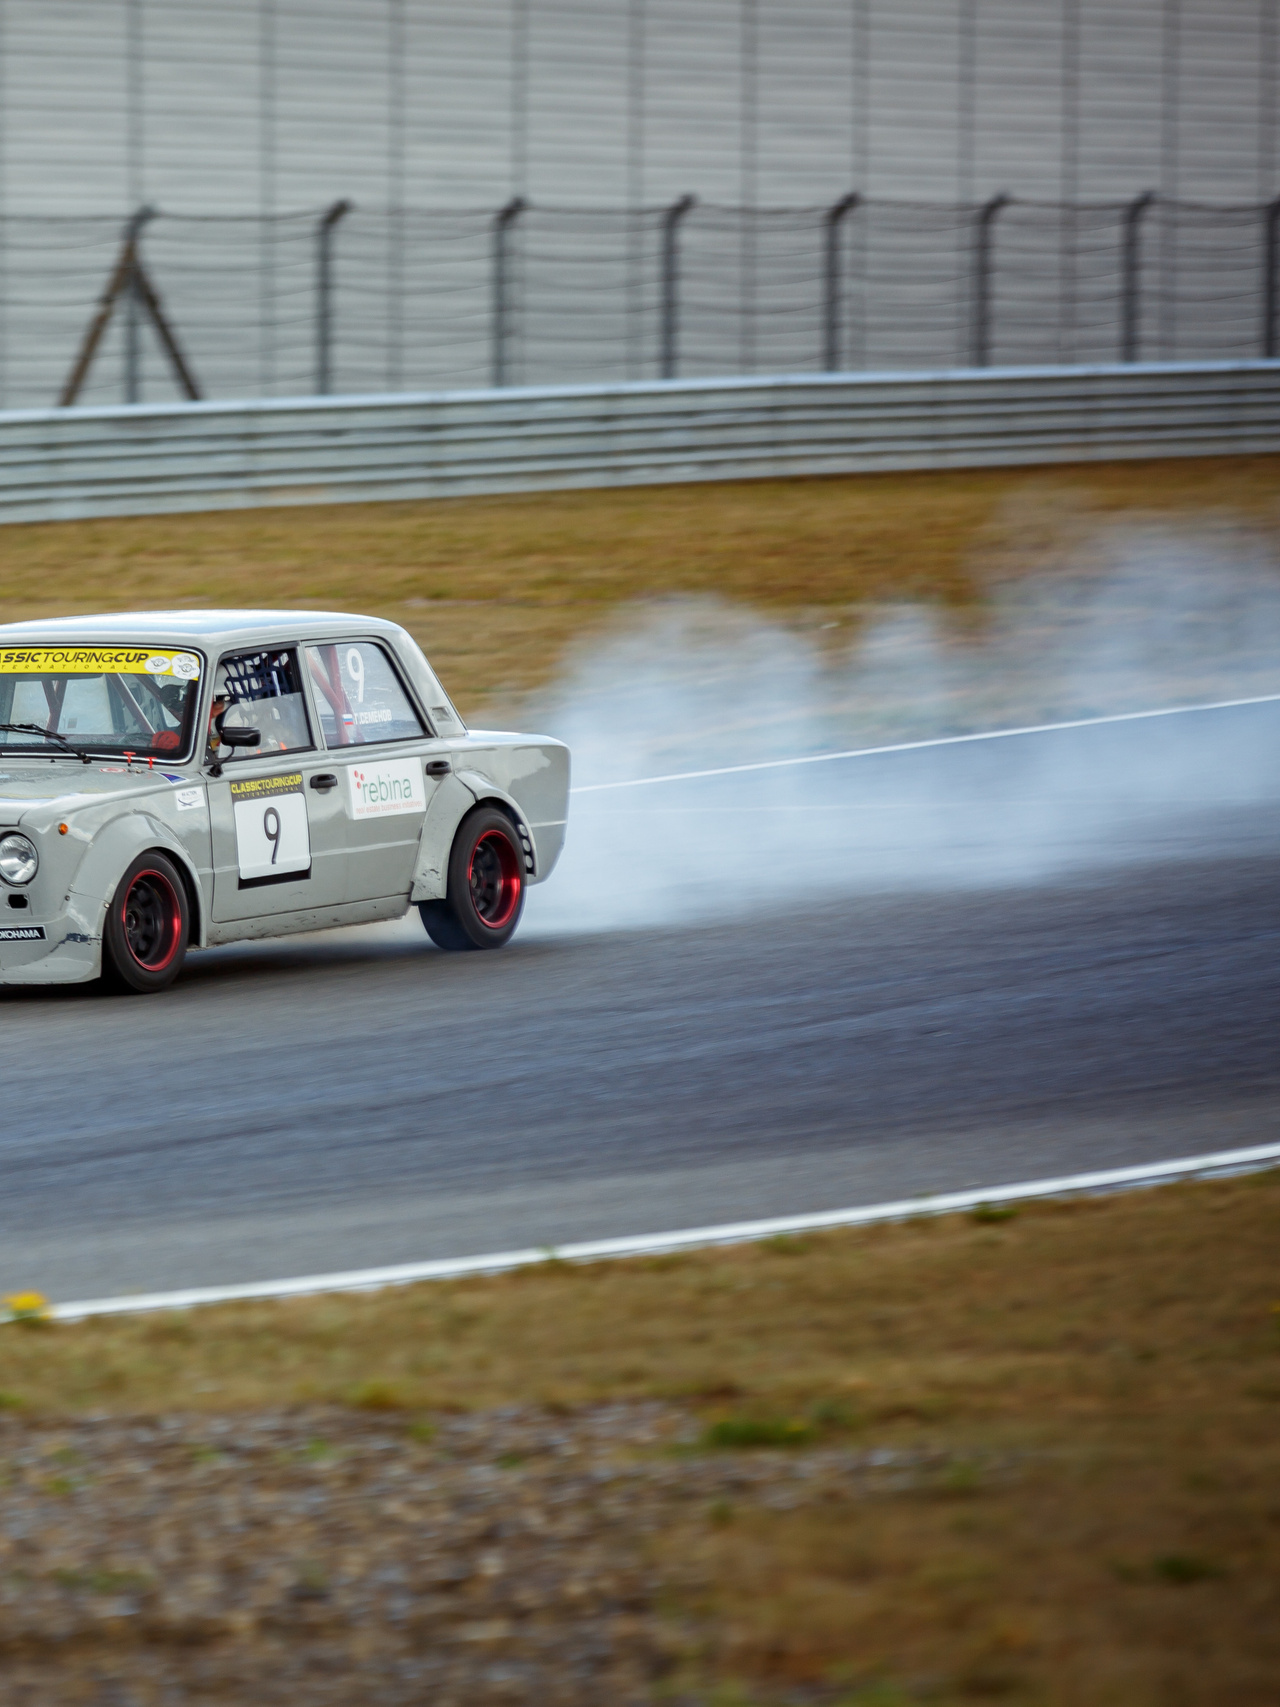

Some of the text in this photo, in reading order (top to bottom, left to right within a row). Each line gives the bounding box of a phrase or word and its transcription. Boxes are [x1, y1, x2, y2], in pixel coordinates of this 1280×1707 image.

[347, 648, 365, 703] 9
[231, 774, 302, 794] CLASSICTOURINGCUP
[362, 774, 413, 803] rebina
[263, 806, 282, 865] 9
